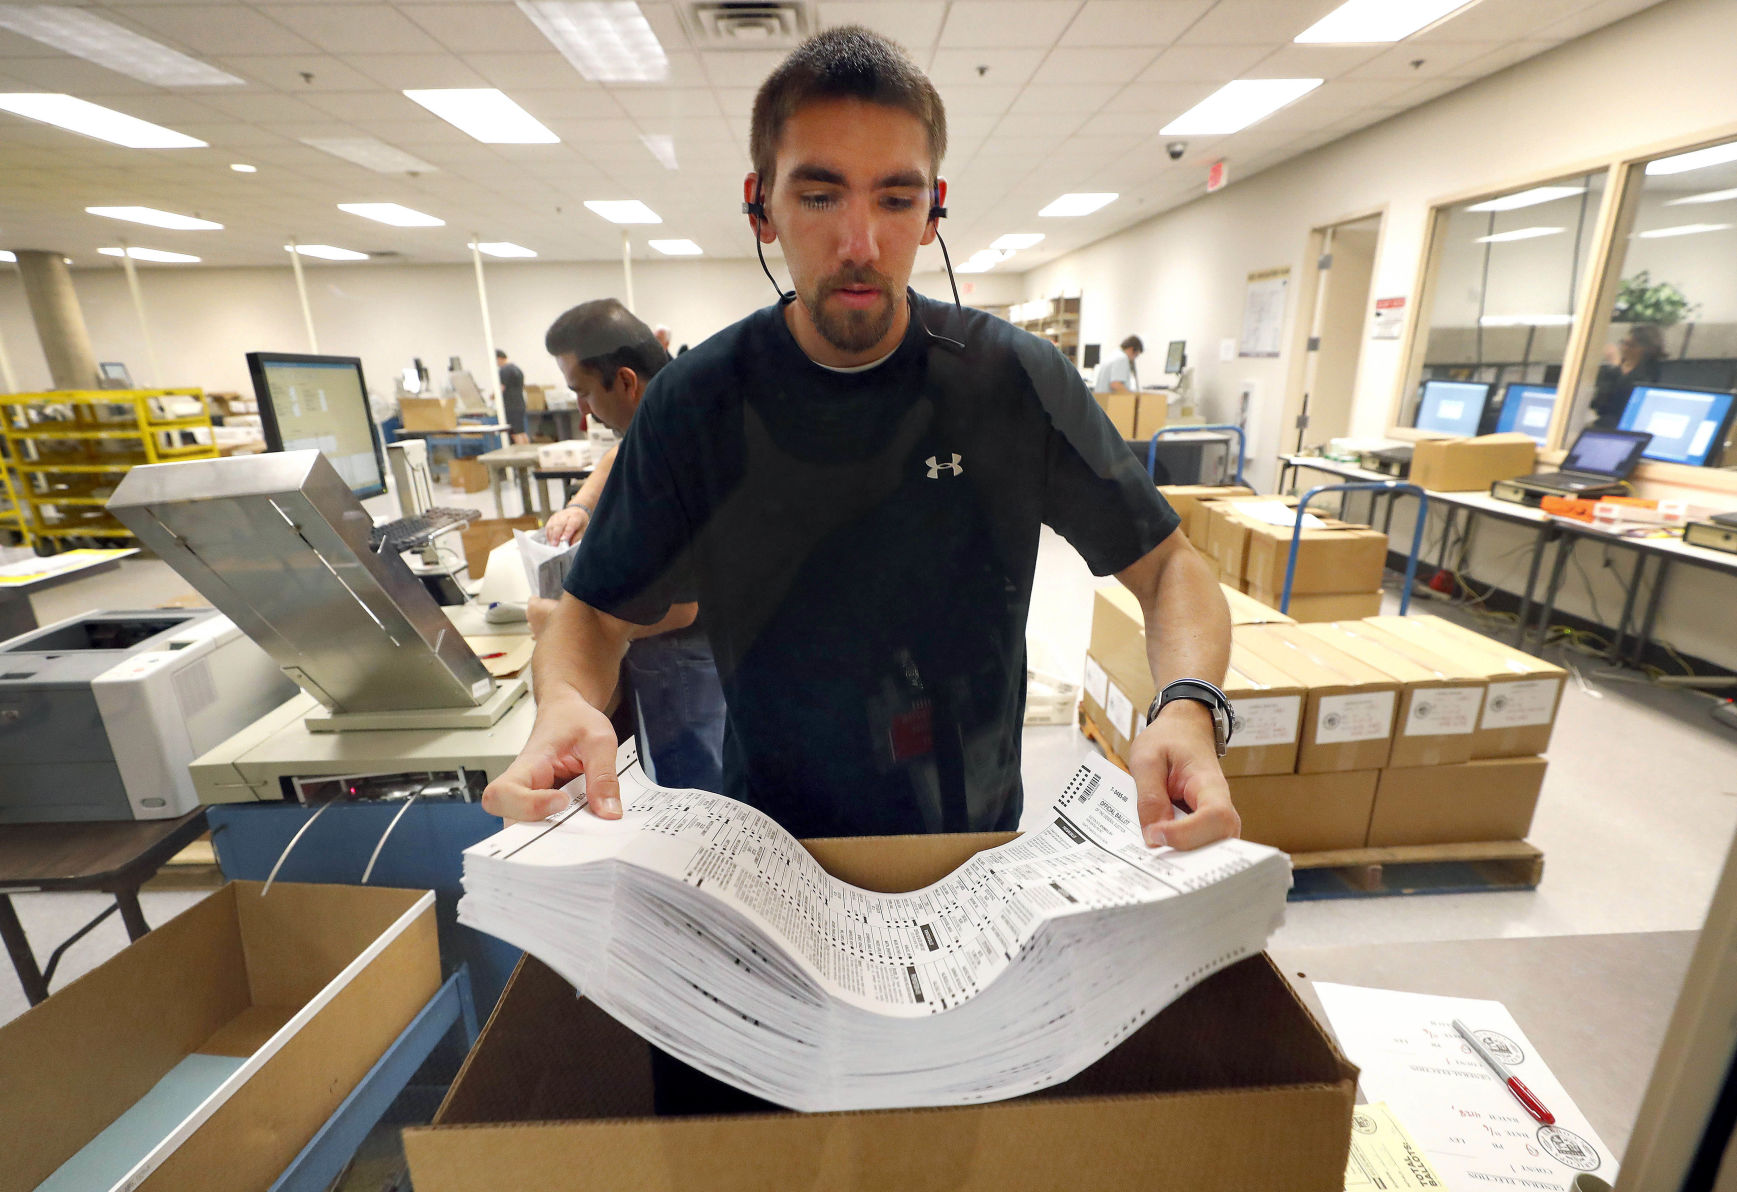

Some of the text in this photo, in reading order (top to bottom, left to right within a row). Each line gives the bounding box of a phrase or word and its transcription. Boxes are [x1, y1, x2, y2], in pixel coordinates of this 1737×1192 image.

[1100, 801, 1130, 825] OFFICIAL BALLOT
[1404, 1156, 1428, 1187] TOTAL
[1466, 1170, 1517, 1185] ELECTION
